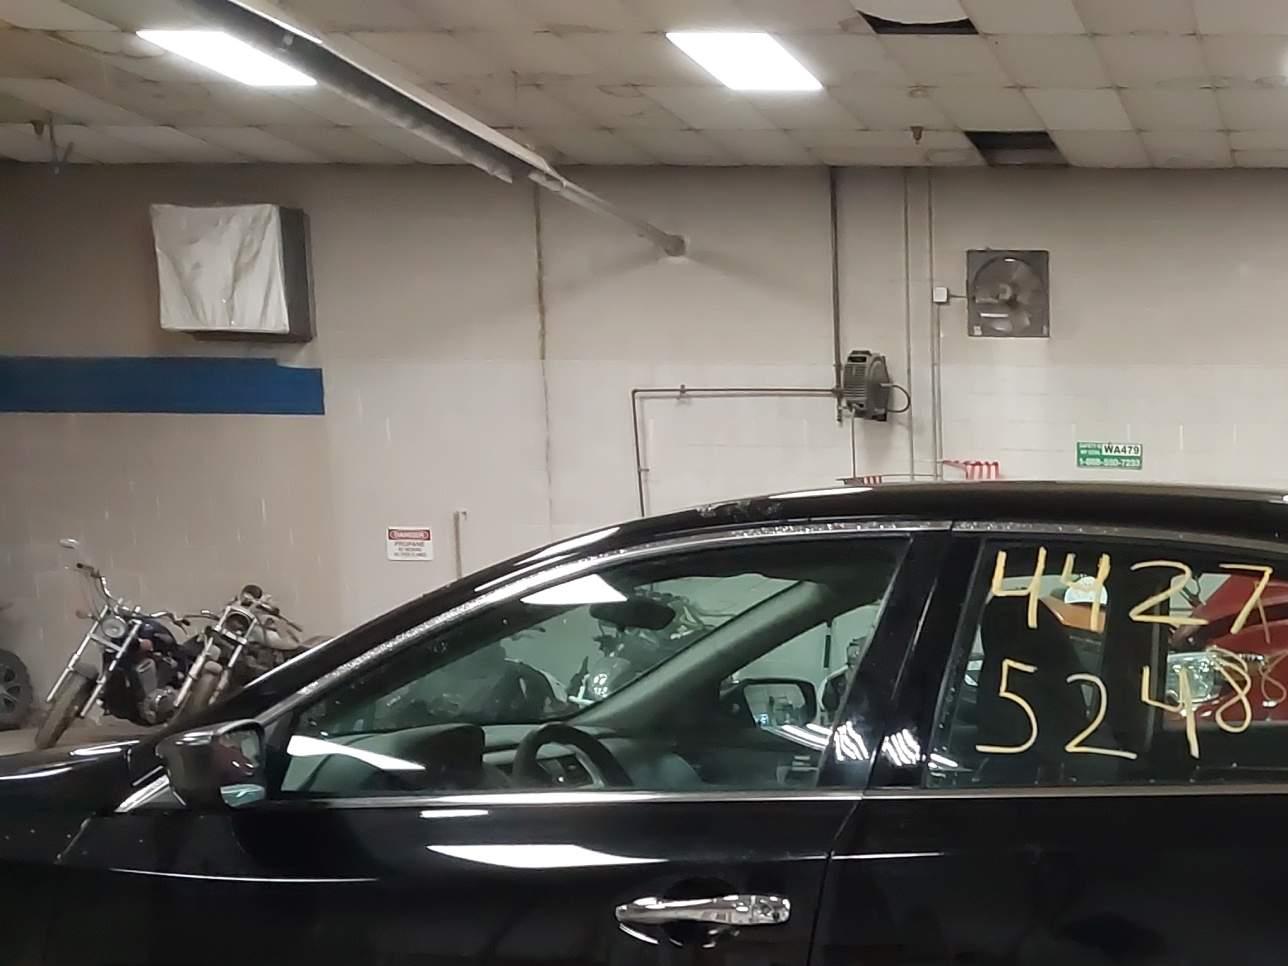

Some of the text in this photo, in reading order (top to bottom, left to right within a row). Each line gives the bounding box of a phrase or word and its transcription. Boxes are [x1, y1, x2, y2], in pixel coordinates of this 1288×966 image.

[1103, 445, 1140, 454] WA479
[991, 546, 1273, 635] 4427
[975, 645, 1252, 759] 5248
